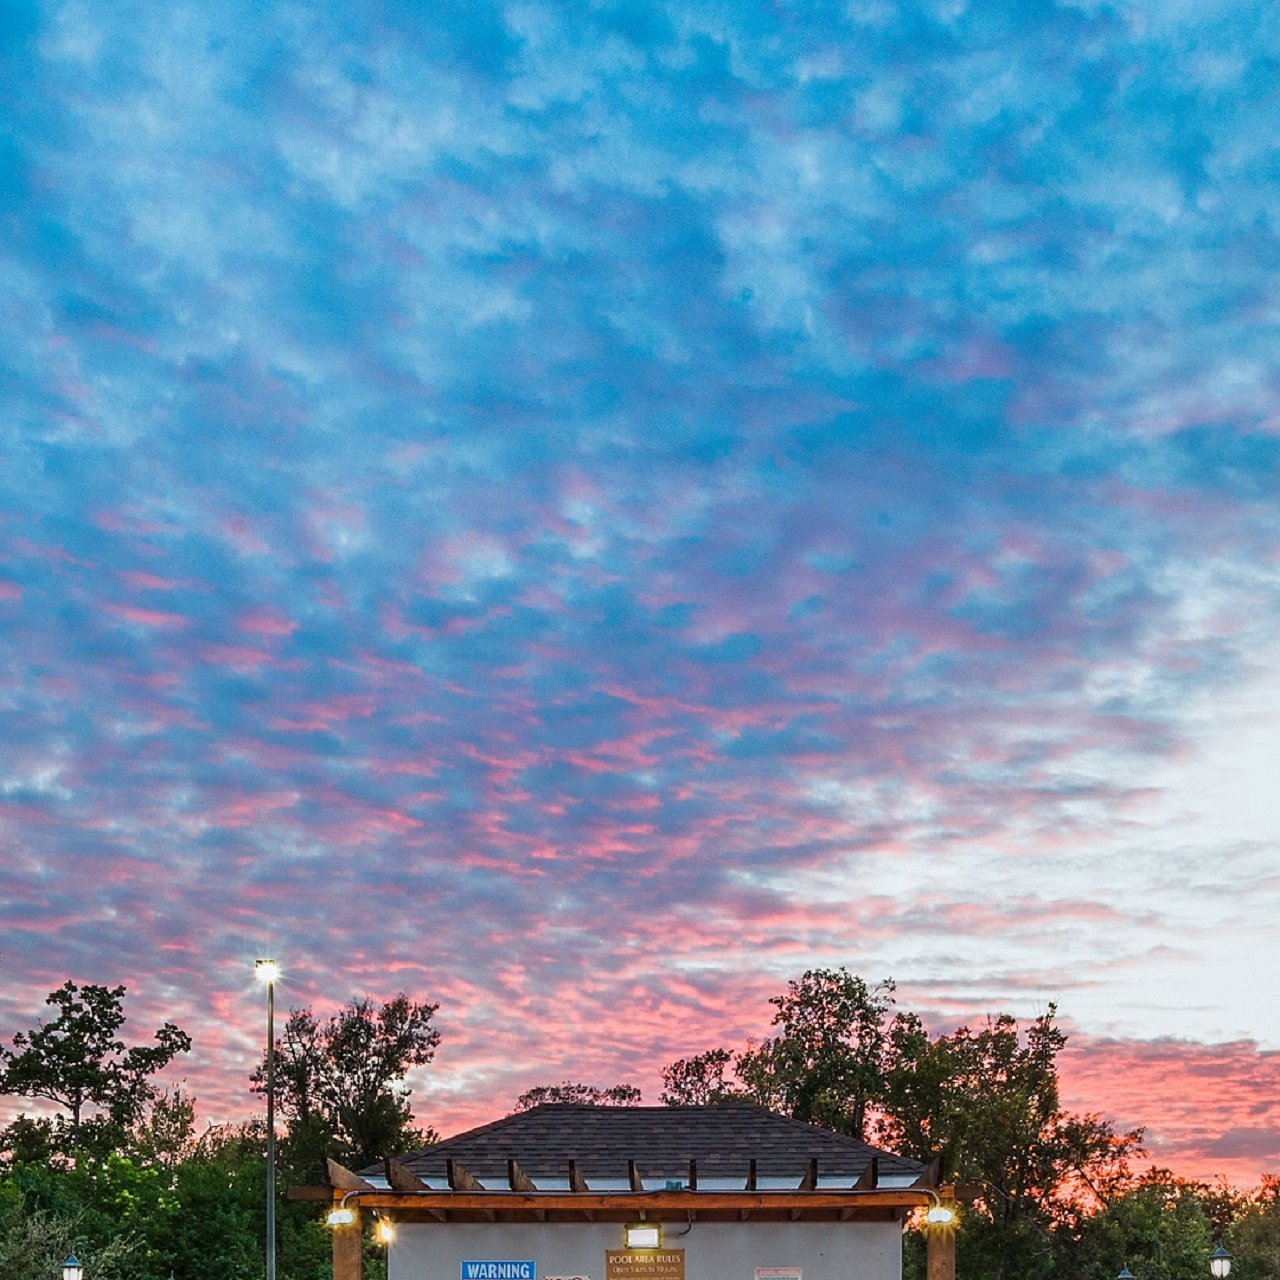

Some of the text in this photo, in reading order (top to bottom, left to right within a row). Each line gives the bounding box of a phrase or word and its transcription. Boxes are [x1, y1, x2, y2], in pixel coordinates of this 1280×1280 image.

[609, 1254, 681, 1264] POOL AREA RULES
[467, 1263, 530, 1279] WARNING
